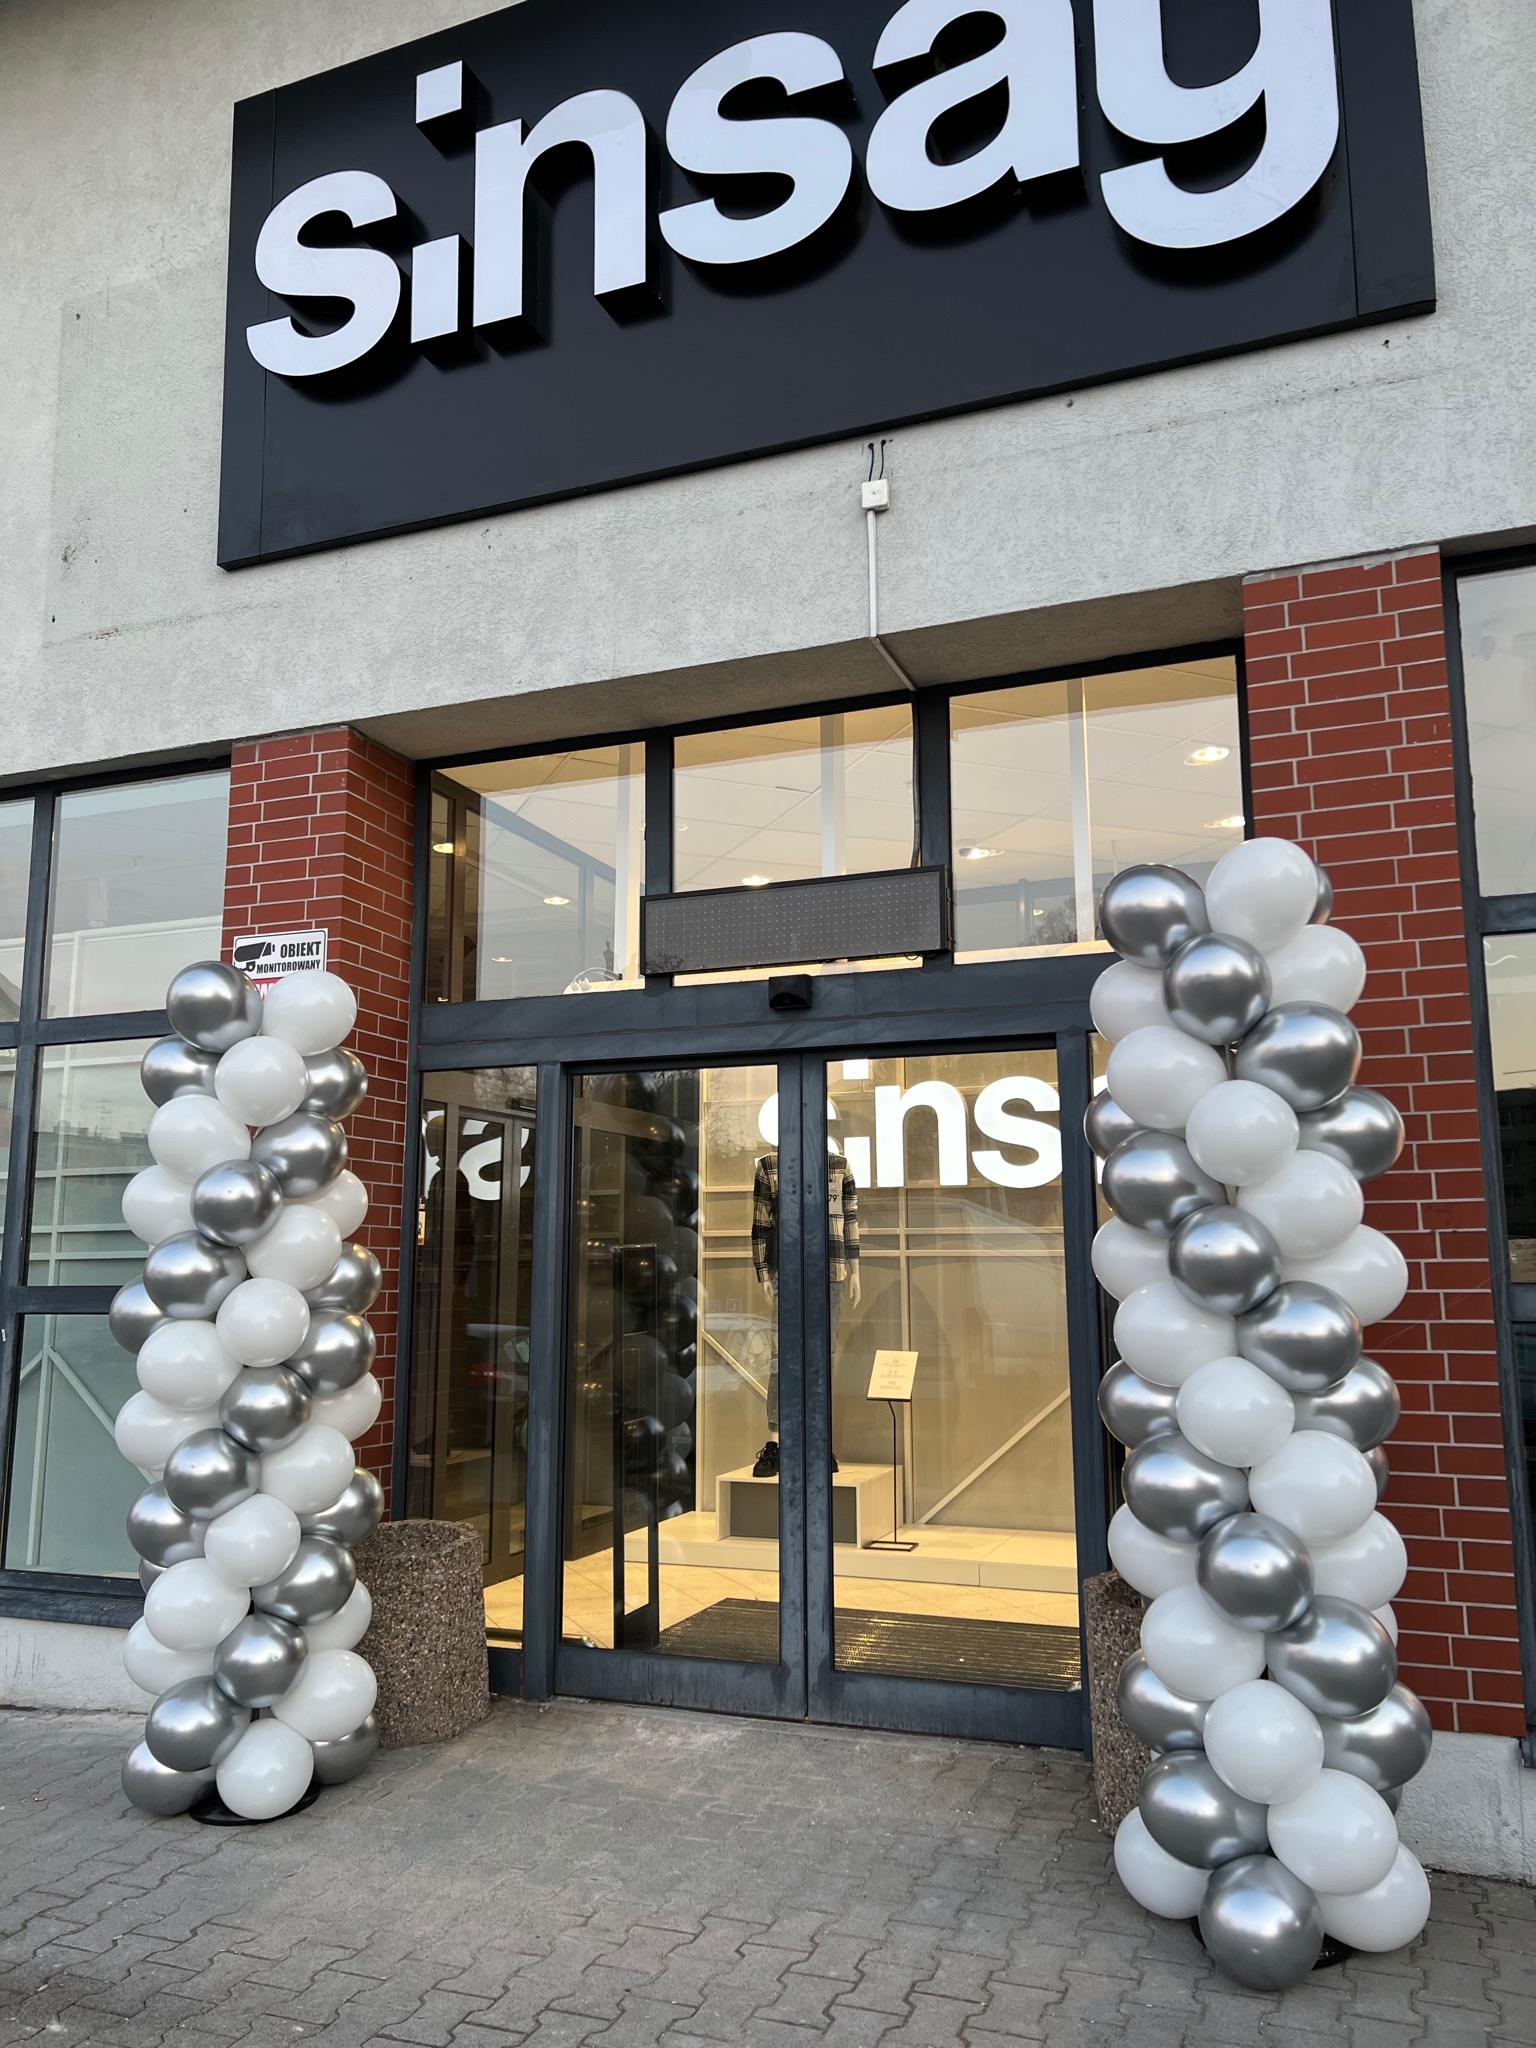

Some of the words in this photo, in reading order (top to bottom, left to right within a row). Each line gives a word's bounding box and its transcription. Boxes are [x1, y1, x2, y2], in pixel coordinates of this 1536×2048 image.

[246, 0, 1340, 376] sinsay
[280, 941, 321, 959] OBIEKT
[256, 959, 321, 974] MONITOROWANY
